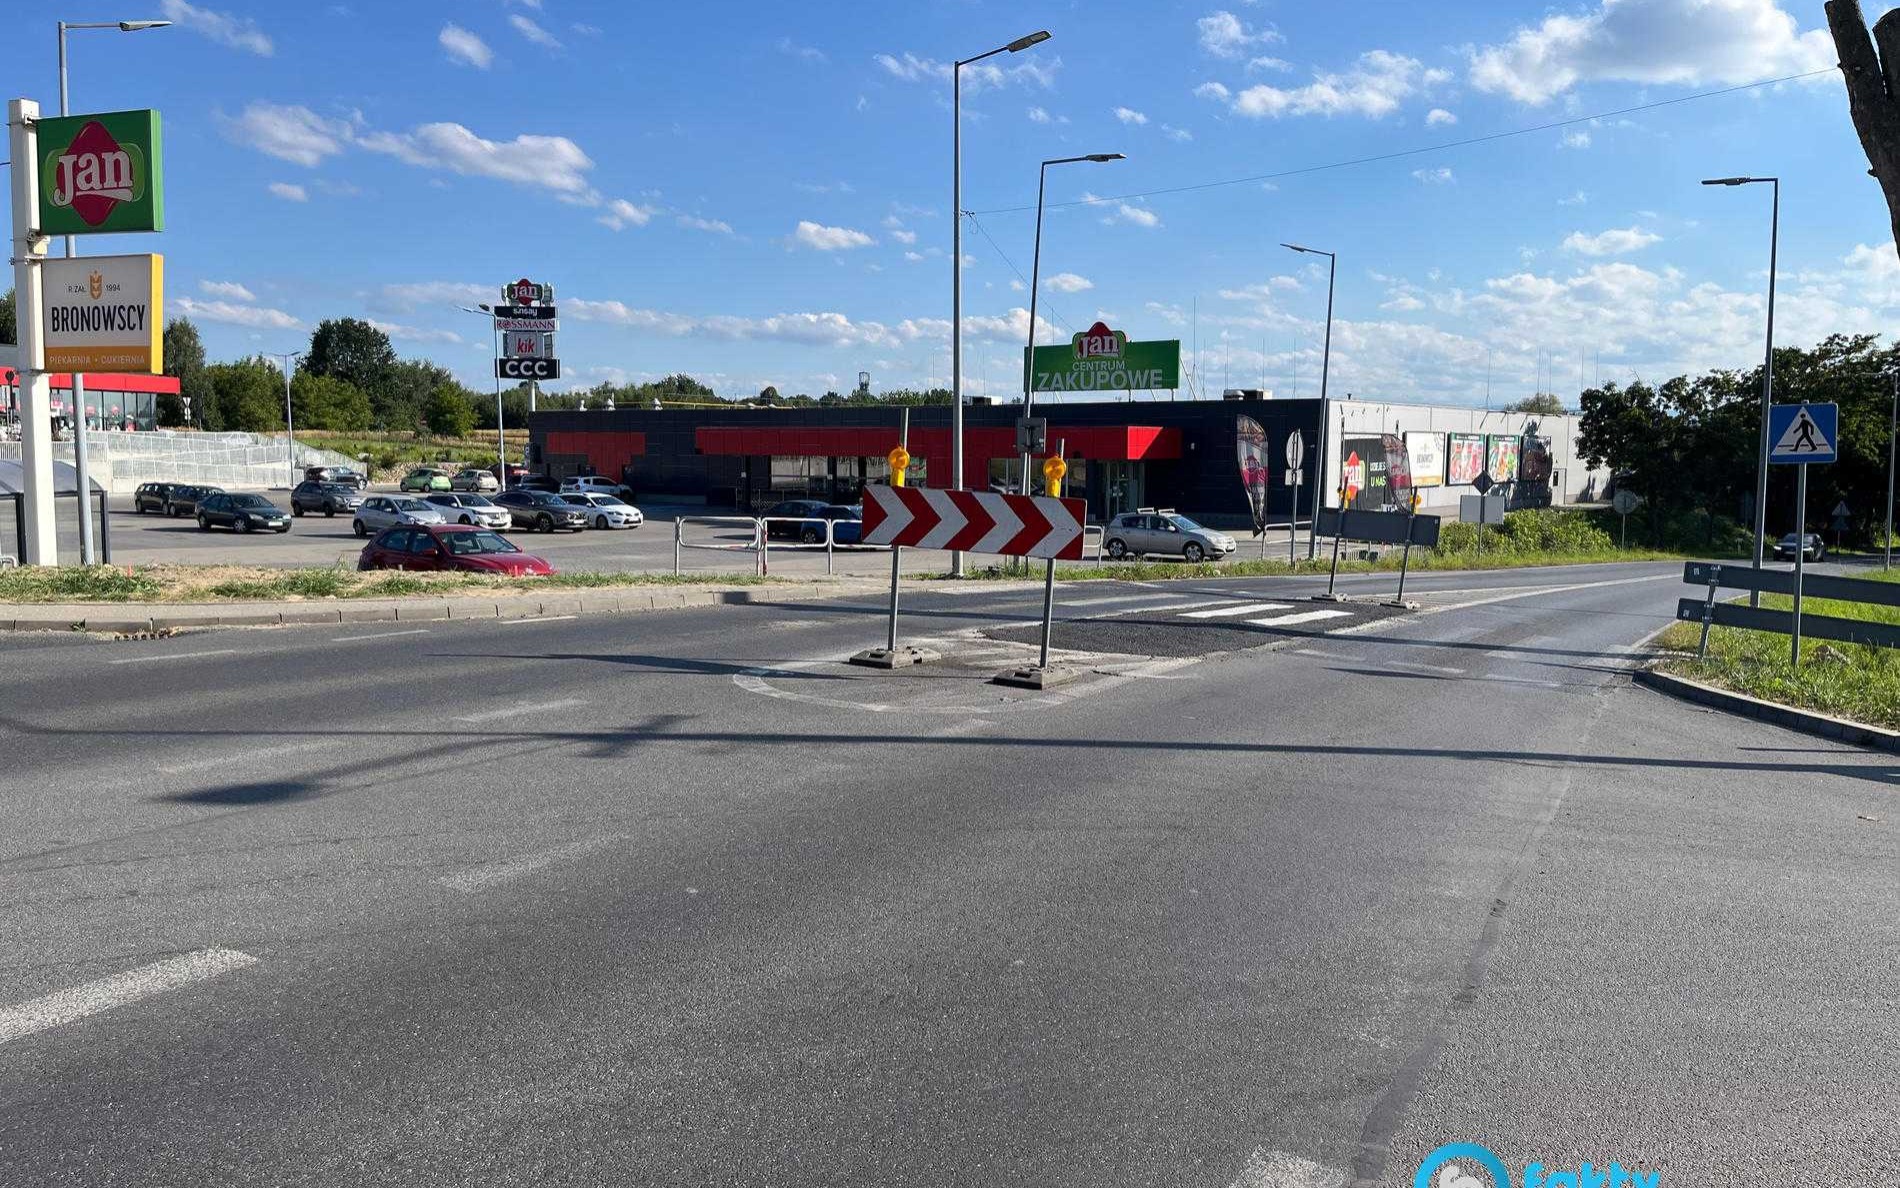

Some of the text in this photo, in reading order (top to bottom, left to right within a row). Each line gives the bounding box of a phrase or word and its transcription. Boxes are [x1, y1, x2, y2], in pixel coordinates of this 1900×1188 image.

[105, 284, 121, 292] 1994
[51, 304, 145, 332] BRONOWSCY
[497, 320, 555, 329] ROSSMANN
[49, 354, 145, 365] PIEKARNIA CUKIERNIA
[505, 361, 548, 375] CCC
[1072, 360, 1125, 372] CENTRUM
[1037, 369, 1163, 390] ZAKUPOWE
